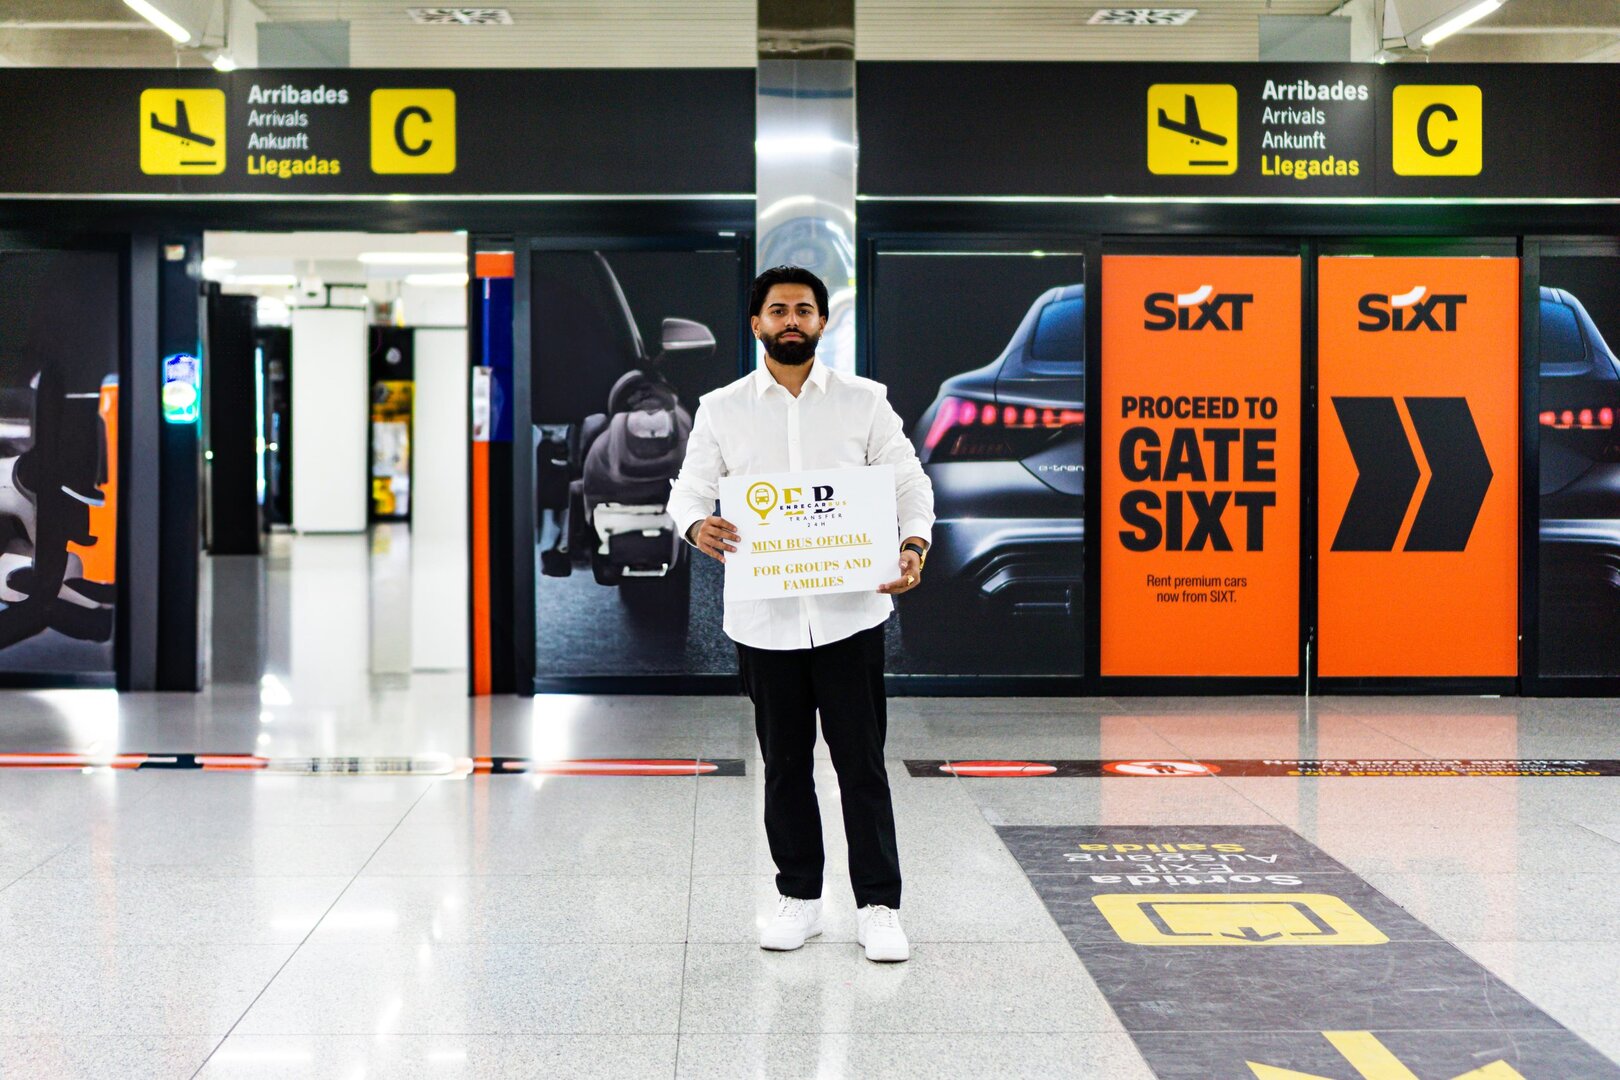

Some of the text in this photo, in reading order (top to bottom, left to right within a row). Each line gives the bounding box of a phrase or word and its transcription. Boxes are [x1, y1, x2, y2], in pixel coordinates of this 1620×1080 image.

[247, 84, 349, 105] Arribades
[1262, 78, 1370, 102] Arribades
[247, 108, 309, 128] Arrivals
[1262, 105, 1326, 127] Arrivals
[394, 105, 432, 156] C
[1262, 129, 1327, 150] Ankunft
[1417, 104, 1459, 156] C
[247, 131, 310, 151] Ankunft
[247, 155, 341, 178] Llegadas
[1261, 155, 1360, 179] Llegadas
[1121, 396, 1278, 420] PROCEED TO
[1119, 427, 1277, 483] GATE
[789, 513, 843, 522] TRANSFER
[1119, 490, 1277, 552] SIXT
[751, 533, 872, 552] MINI BUS OFICIAL
[753, 558, 872, 577] FOR GROUPS AND
[783, 576, 844, 590] FAMILIES
[1147, 575, 1247, 590] Rent premium cars
[1156, 590, 1238, 603] now from SIXT.
[1063, 852, 1279, 863] Ausgang
[1078, 843, 1246, 853] Salida
[1136, 863, 1235, 874] Exit
[1089, 874, 1303, 886] Sortida
